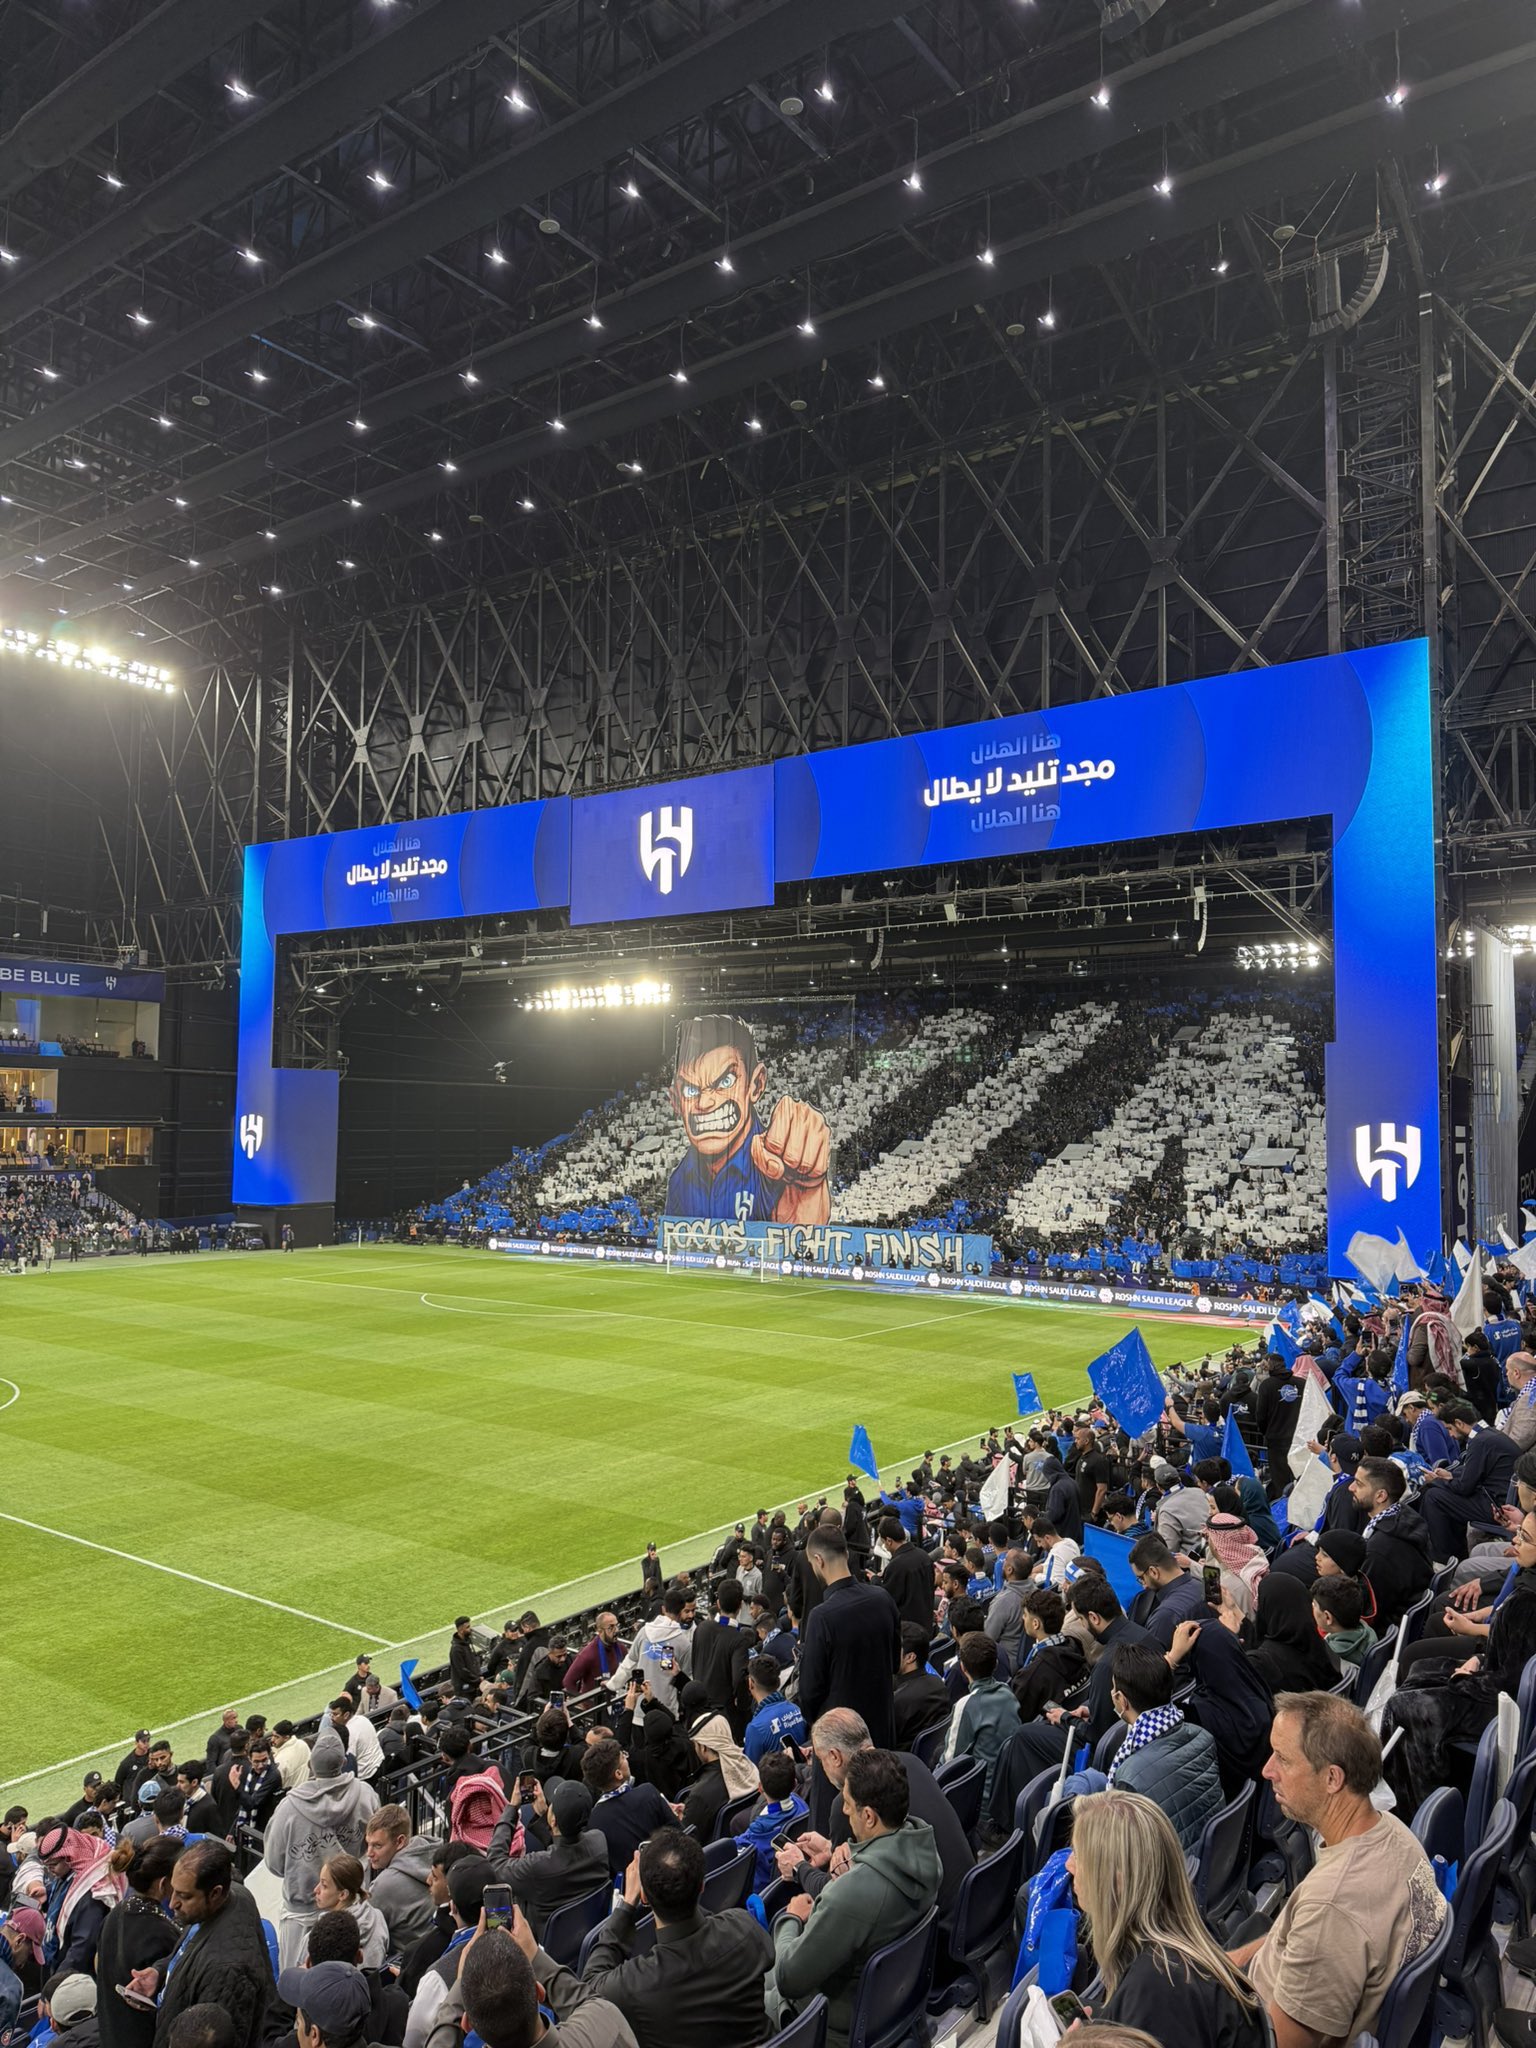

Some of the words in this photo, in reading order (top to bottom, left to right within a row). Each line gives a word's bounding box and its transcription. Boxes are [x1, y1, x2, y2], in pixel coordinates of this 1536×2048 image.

[971, 735, 1028, 765] الهلال
[1032, 733, 1062, 753] هنا
[985, 766, 1003, 795] لا
[1006, 758, 1061, 796] تليد
[1061, 759, 1116, 787] مجد
[923, 776, 982, 807] يطال
[971, 805, 1028, 833] الهلال
[1032, 803, 1062, 823] هنا
[373, 838, 403, 857] الهلال
[405, 837, 421, 851] هنا
[346, 864, 379, 885] يطال
[380, 859, 391, 879] لا
[391, 856, 420, 882] تليد
[419, 858, 448, 878] مجد
[371, 888, 402, 906] الهلال
[403, 887, 420, 901] هنا
[0, 968, 25, 982] BE
[31, 970, 80, 986] BLUE
[941, 1277, 963, 1286] ROSHN
[964, 1278, 980, 1287] SAUDI
[981, 1280, 1008, 1290] LEAGUE
[1024, 1284, 1048, 1294] ROSHN
[1048, 1286, 1069, 1295] SAUDI
[1070, 1288, 1097, 1298] LEAGUE
[1114, 1292, 1140, 1301] ROSHN
[1141, 1294, 1164, 1304] SAUDI
[1165, 1296, 1194, 1307] LEAGUE
[1213, 1302, 1242, 1311] ROSHN
[1242, 1304, 1267, 1313] SAUDI
